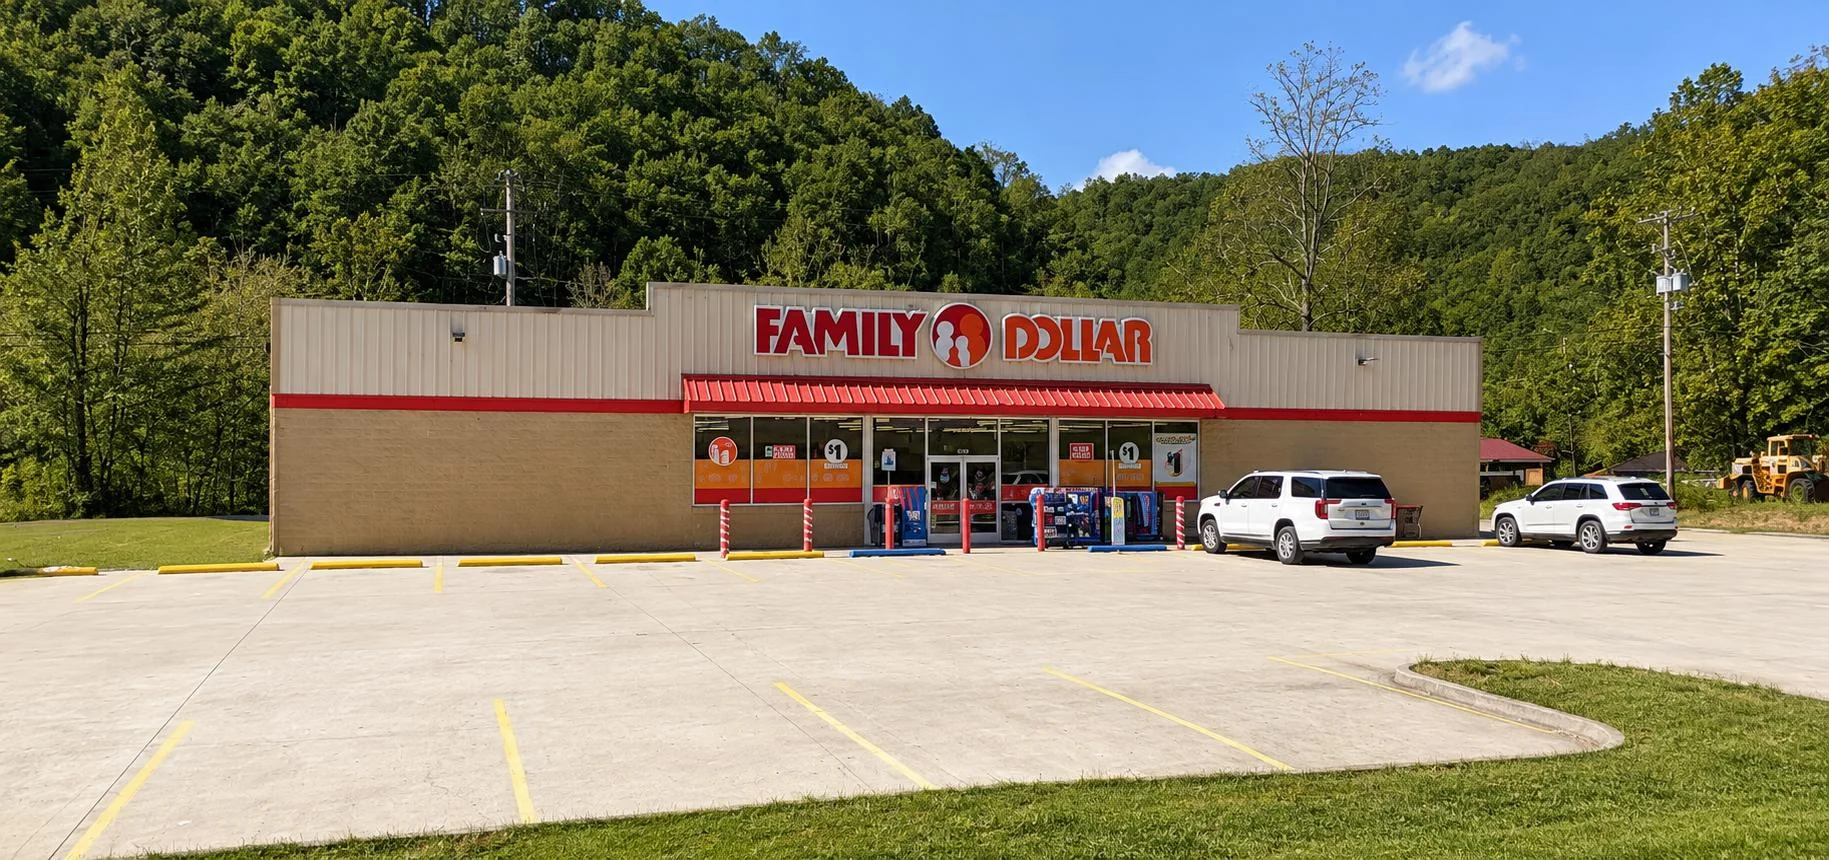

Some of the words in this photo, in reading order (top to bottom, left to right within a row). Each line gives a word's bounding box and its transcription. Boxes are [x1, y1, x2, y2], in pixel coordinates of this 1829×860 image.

[754, 304, 928, 359] FAMILY
[1002, 313, 1152, 365] DOLLAR
[828, 444, 842, 460] $1
[1122, 446, 1135, 461] $1
